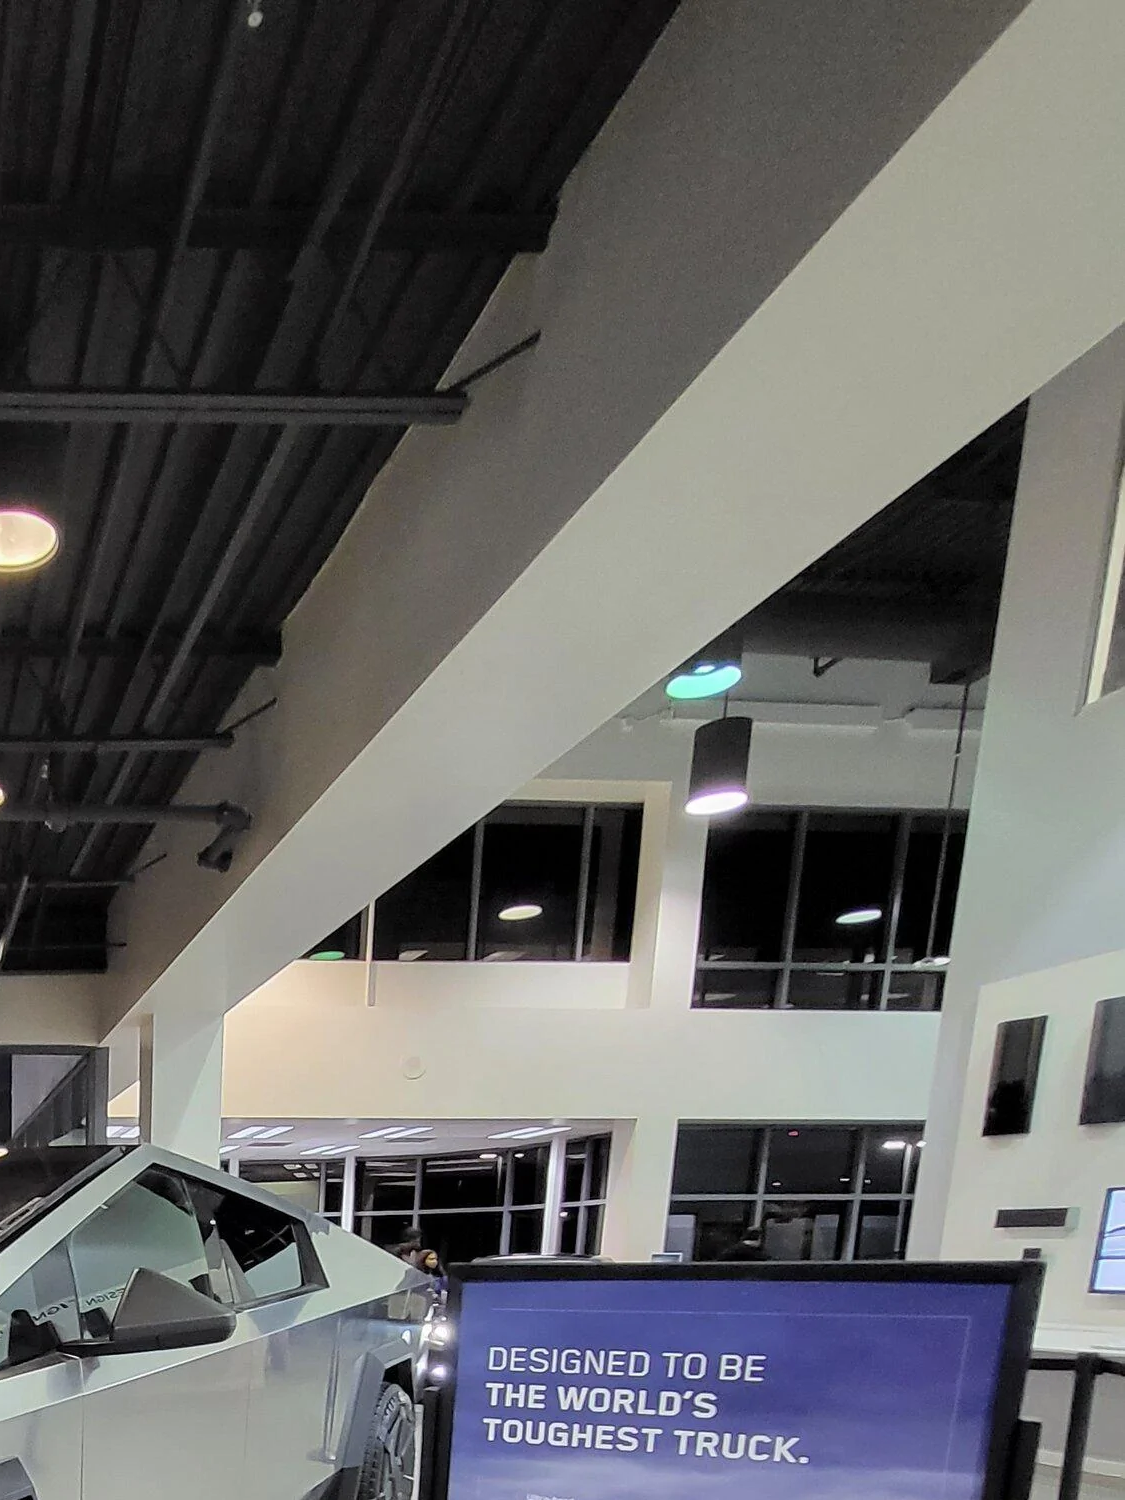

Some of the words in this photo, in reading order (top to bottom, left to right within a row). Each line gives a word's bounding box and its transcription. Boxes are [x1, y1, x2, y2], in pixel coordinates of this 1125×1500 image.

[488, 1346, 651, 1378] DESIGNED
[662, 1352, 708, 1380] TO
[718, 1354, 767, 1382] BE
[485, 1382, 547, 1409] THE
[557, 1385, 718, 1419] WORLD'S
[482, 1417, 663, 1453] TOUGHEST
[674, 1430, 810, 1464] TRUCK.
